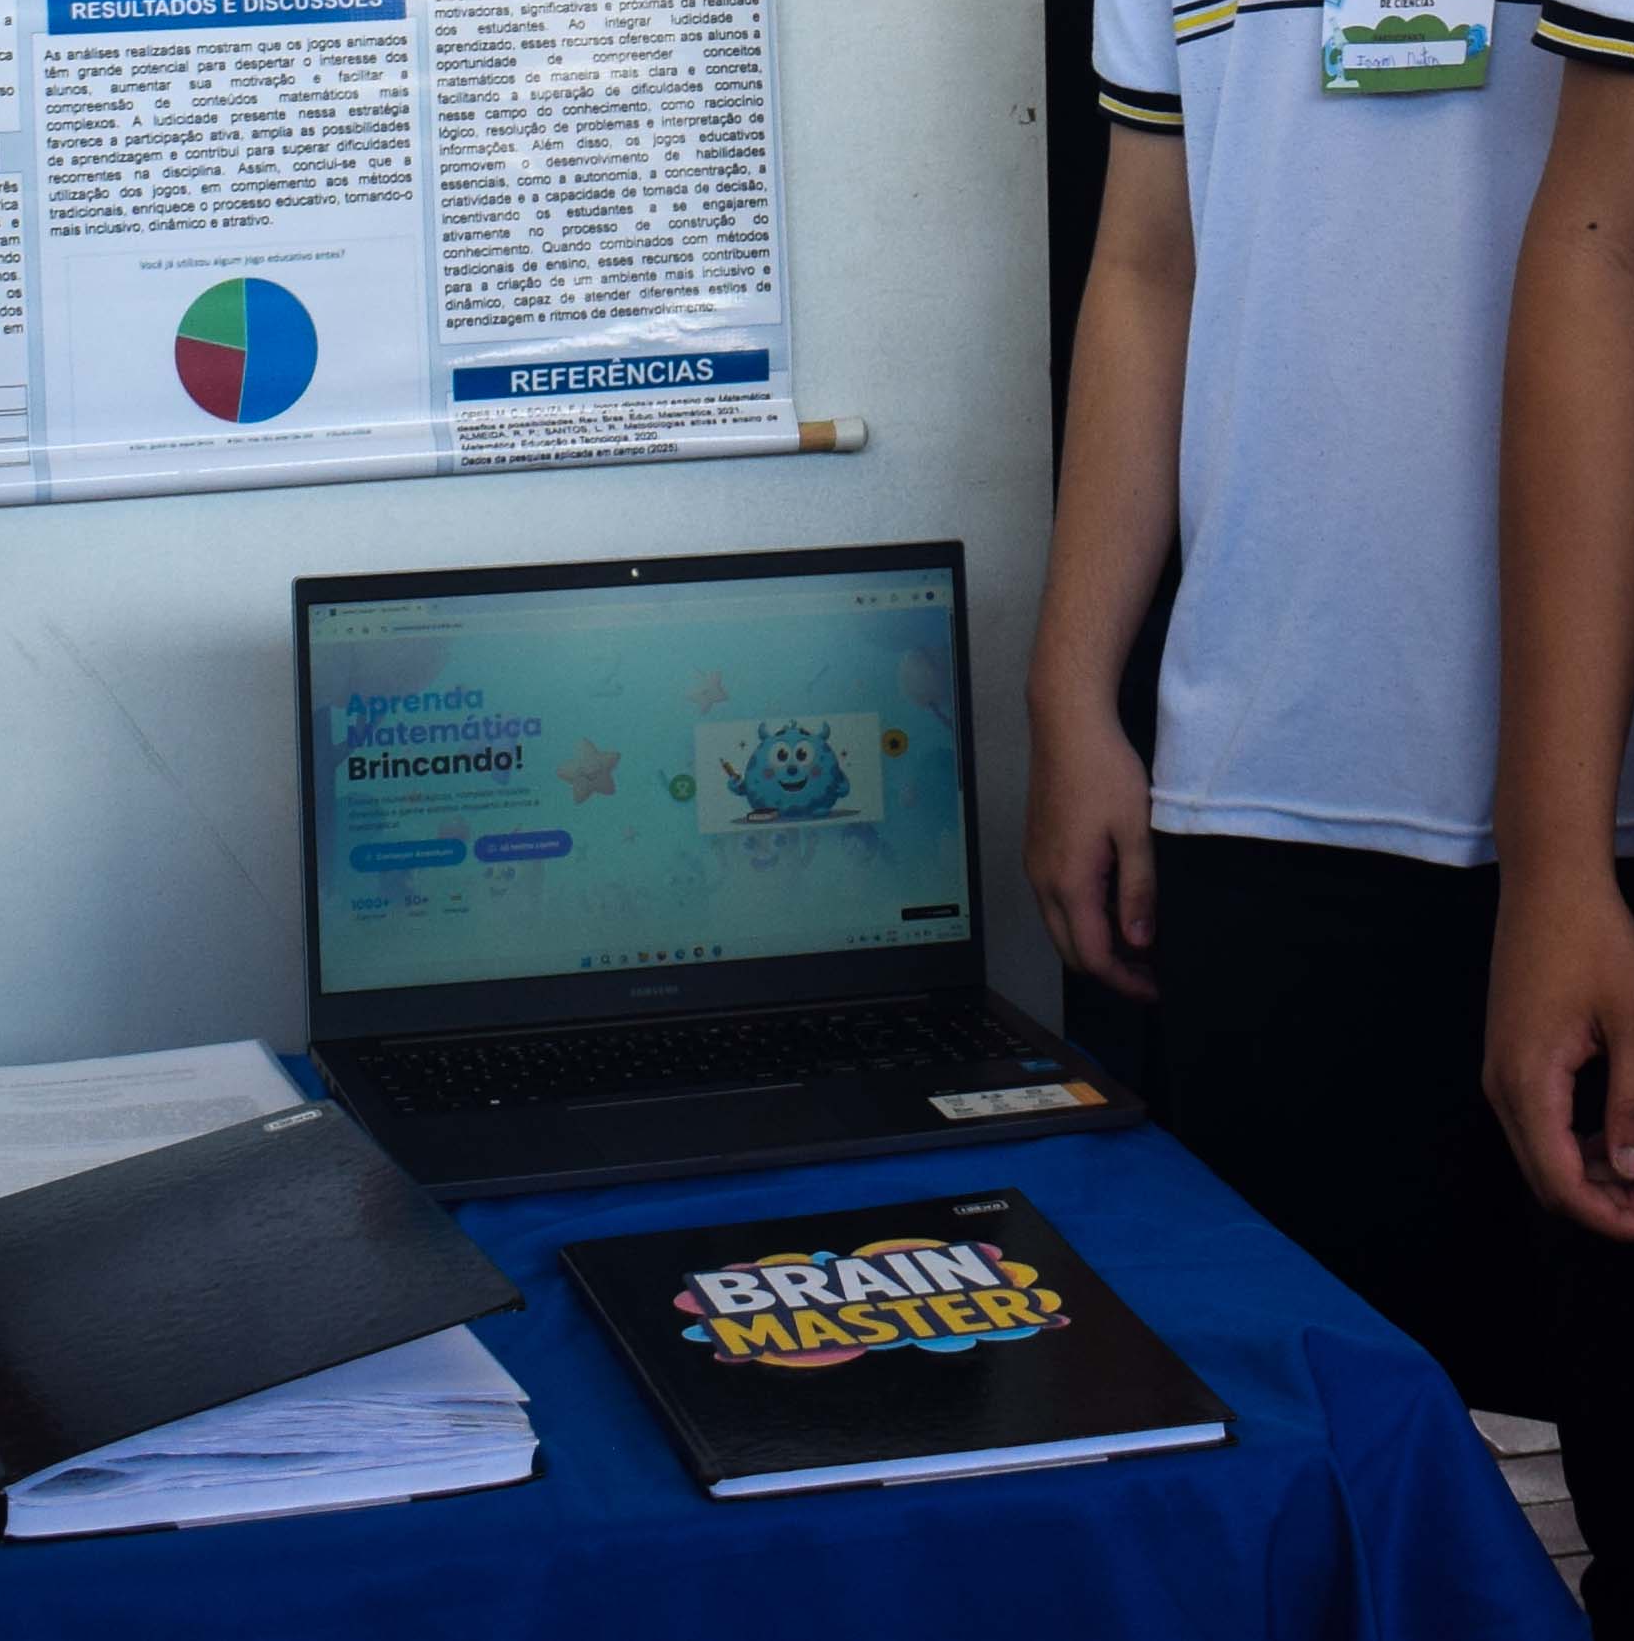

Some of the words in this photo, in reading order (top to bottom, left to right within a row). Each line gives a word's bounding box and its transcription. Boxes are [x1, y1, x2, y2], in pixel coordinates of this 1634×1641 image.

[434, 1, 513, 20] motivadoras,
[604, 2, 612, 11] e
[43, 46, 61, 60] As
[66, 44, 120, 59] análises
[125, 41, 191, 57] realizadas
[196, 39, 252, 54] mostram
[257, 42, 281, 55] que
[286, 41, 302, 50] os
[306, 35, 341, 53] jogos
[346, 33, 407, 48] animados
[46, 132, 103, 147] favorece
[109, 135, 118, 144] a
[124, 128, 203, 147] participação
[209, 126, 243, 144] ativa,
[251, 124, 293, 142] amplia
[299, 127, 315, 137] as
[321, 119, 410, 139] possibilidades
[50, 220, 81, 235] mais
[85, 218, 144, 237] inclusivo,
[148, 215, 206, 231] dinâmico
[210, 219, 218, 228] e
[222, 213, 273, 228] atrativo.
[442, 239, 533, 257] conhecimento.
[541, 237, 591, 252] Quando
[599, 233, 674, 249] combinados
[681, 235, 708, 245] com
[716, 228, 769, 244] métodos
[511, 358, 713, 393] REFERÊNCIAS
[346, 686, 483, 722] Aprenda
[348, 714, 542, 749] Matemática
[348, 745, 523, 781] Brincando!
[694, 1244, 1002, 1314] BRAIN
[706, 1287, 1048, 1355] MASTER
